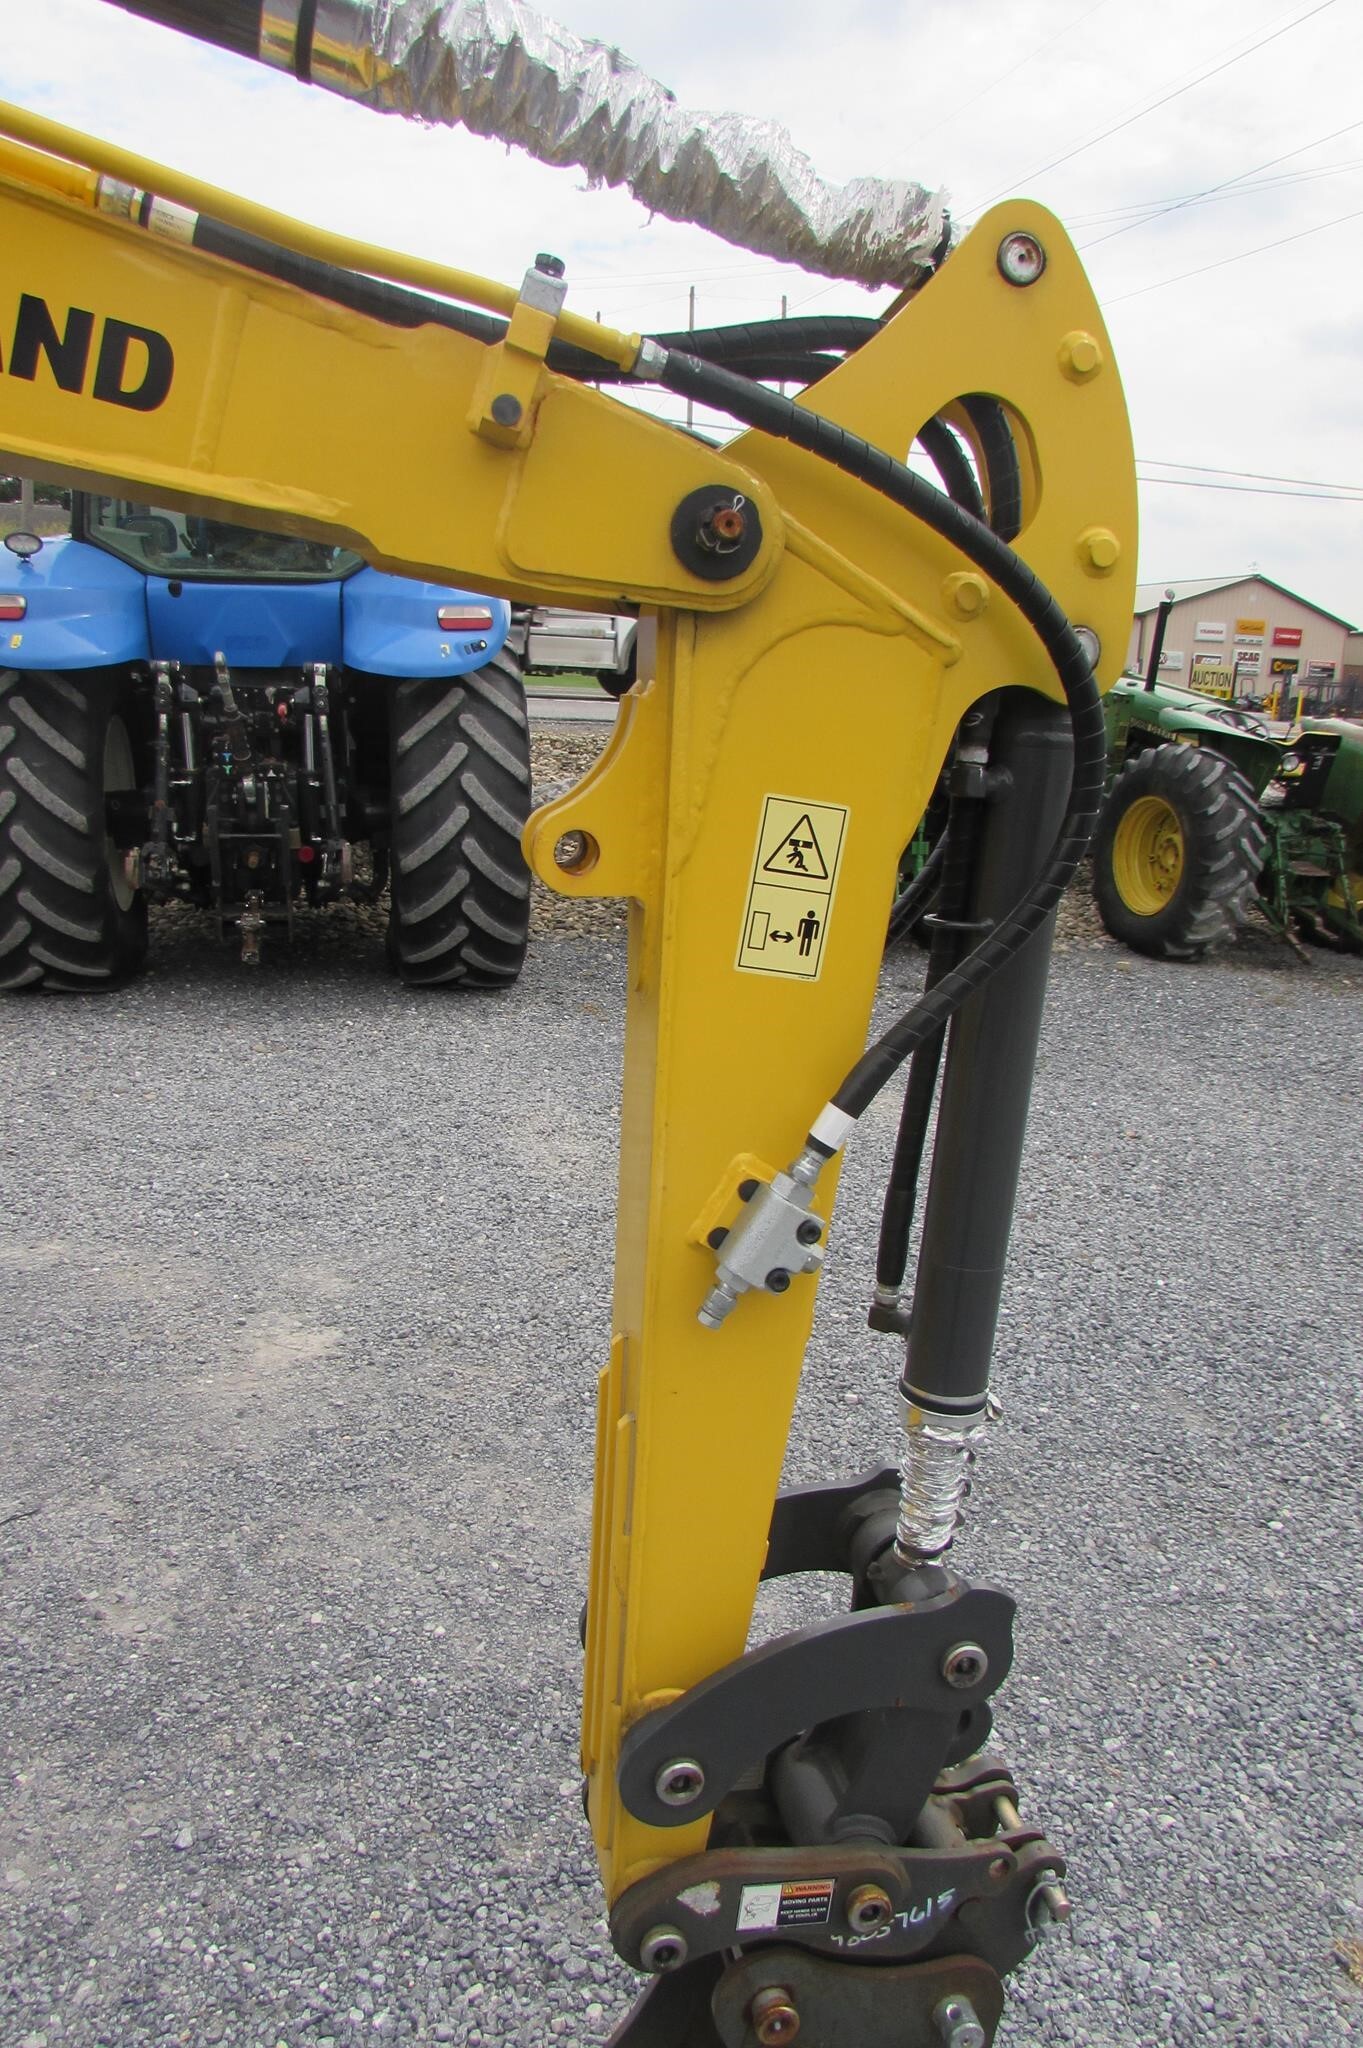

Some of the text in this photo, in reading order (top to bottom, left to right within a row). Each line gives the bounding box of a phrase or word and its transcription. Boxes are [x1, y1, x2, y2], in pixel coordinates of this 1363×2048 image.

[0, 293, 174, 412] ND
[1237, 651, 1260, 662] SCAG
[1191, 670, 1232, 687] AUCTION
[795, 1884, 830, 1893] WARNING
